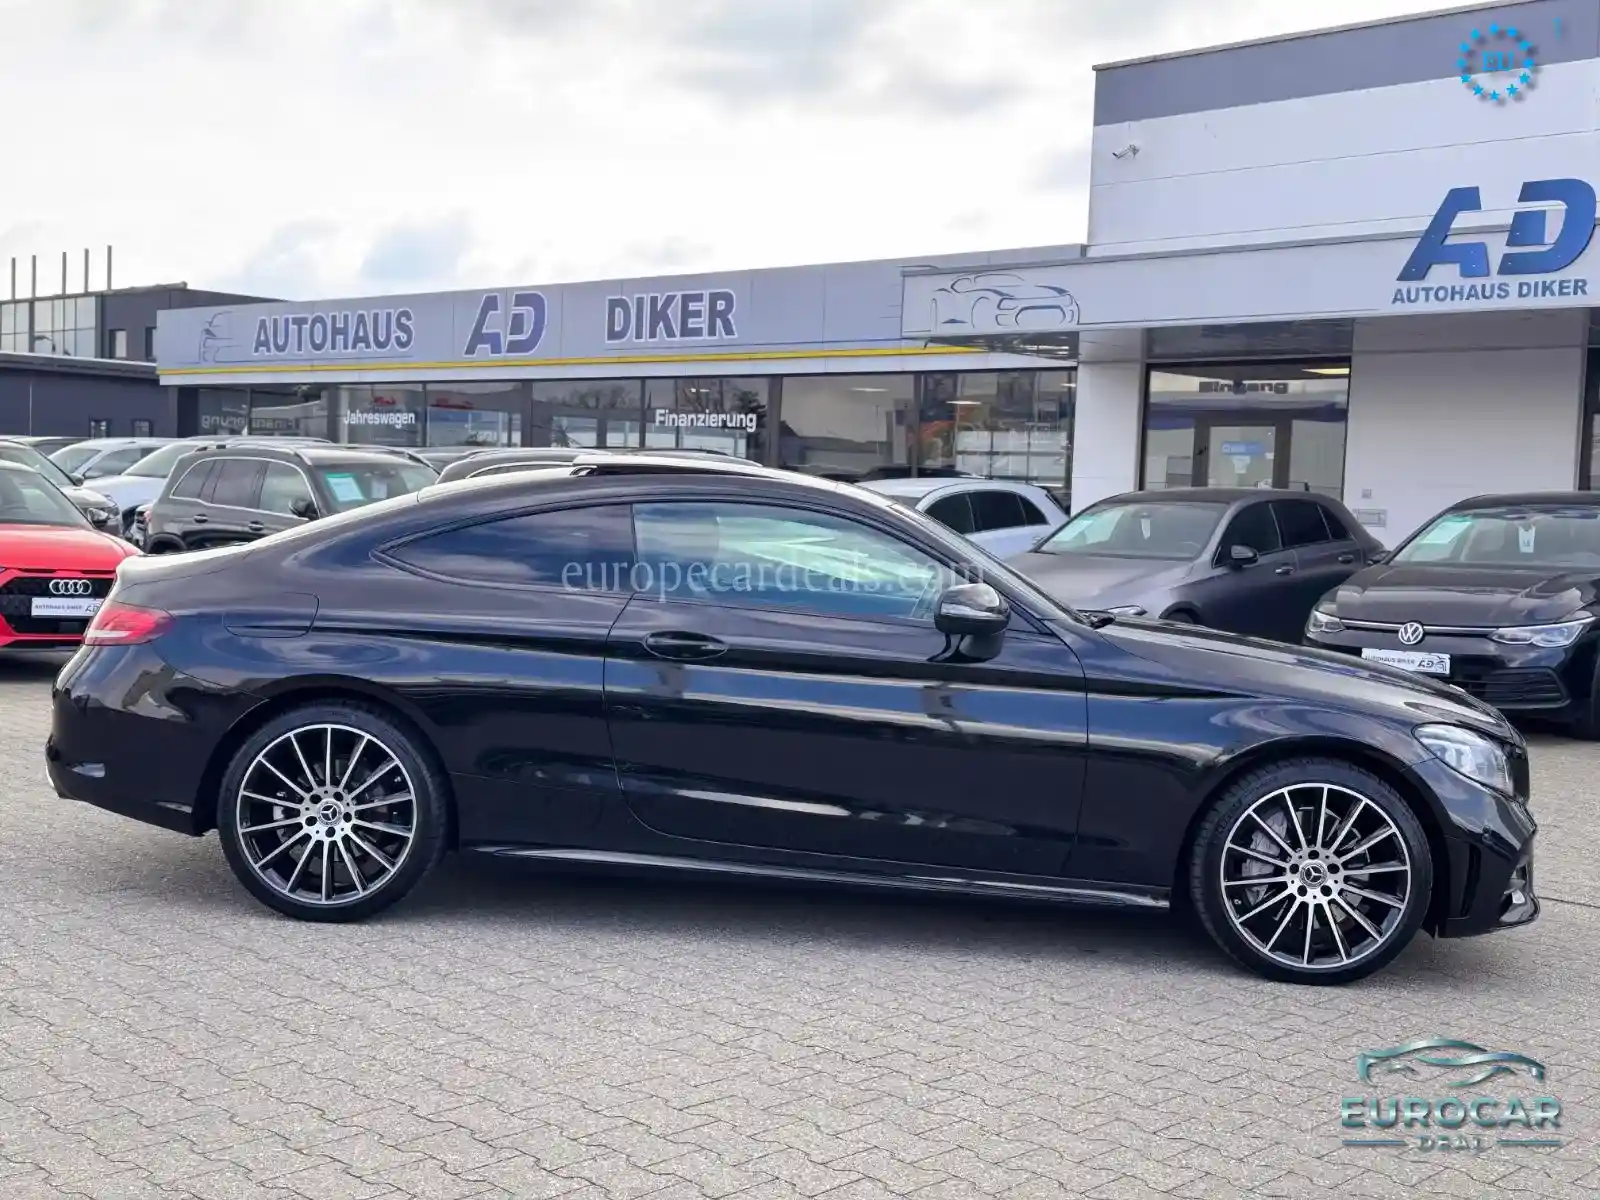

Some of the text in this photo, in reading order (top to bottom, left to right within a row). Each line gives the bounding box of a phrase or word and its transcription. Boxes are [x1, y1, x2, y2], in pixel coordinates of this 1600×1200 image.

[1396, 178, 1597, 281] AD
[1391, 278, 1589, 304] AUTOHAUS DIKER
[252, 289, 738, 356] AUTOHAUS AD DIKER
[343, 409, 416, 429] Jahreswagen
[655, 409, 757, 433] Finanzierung
